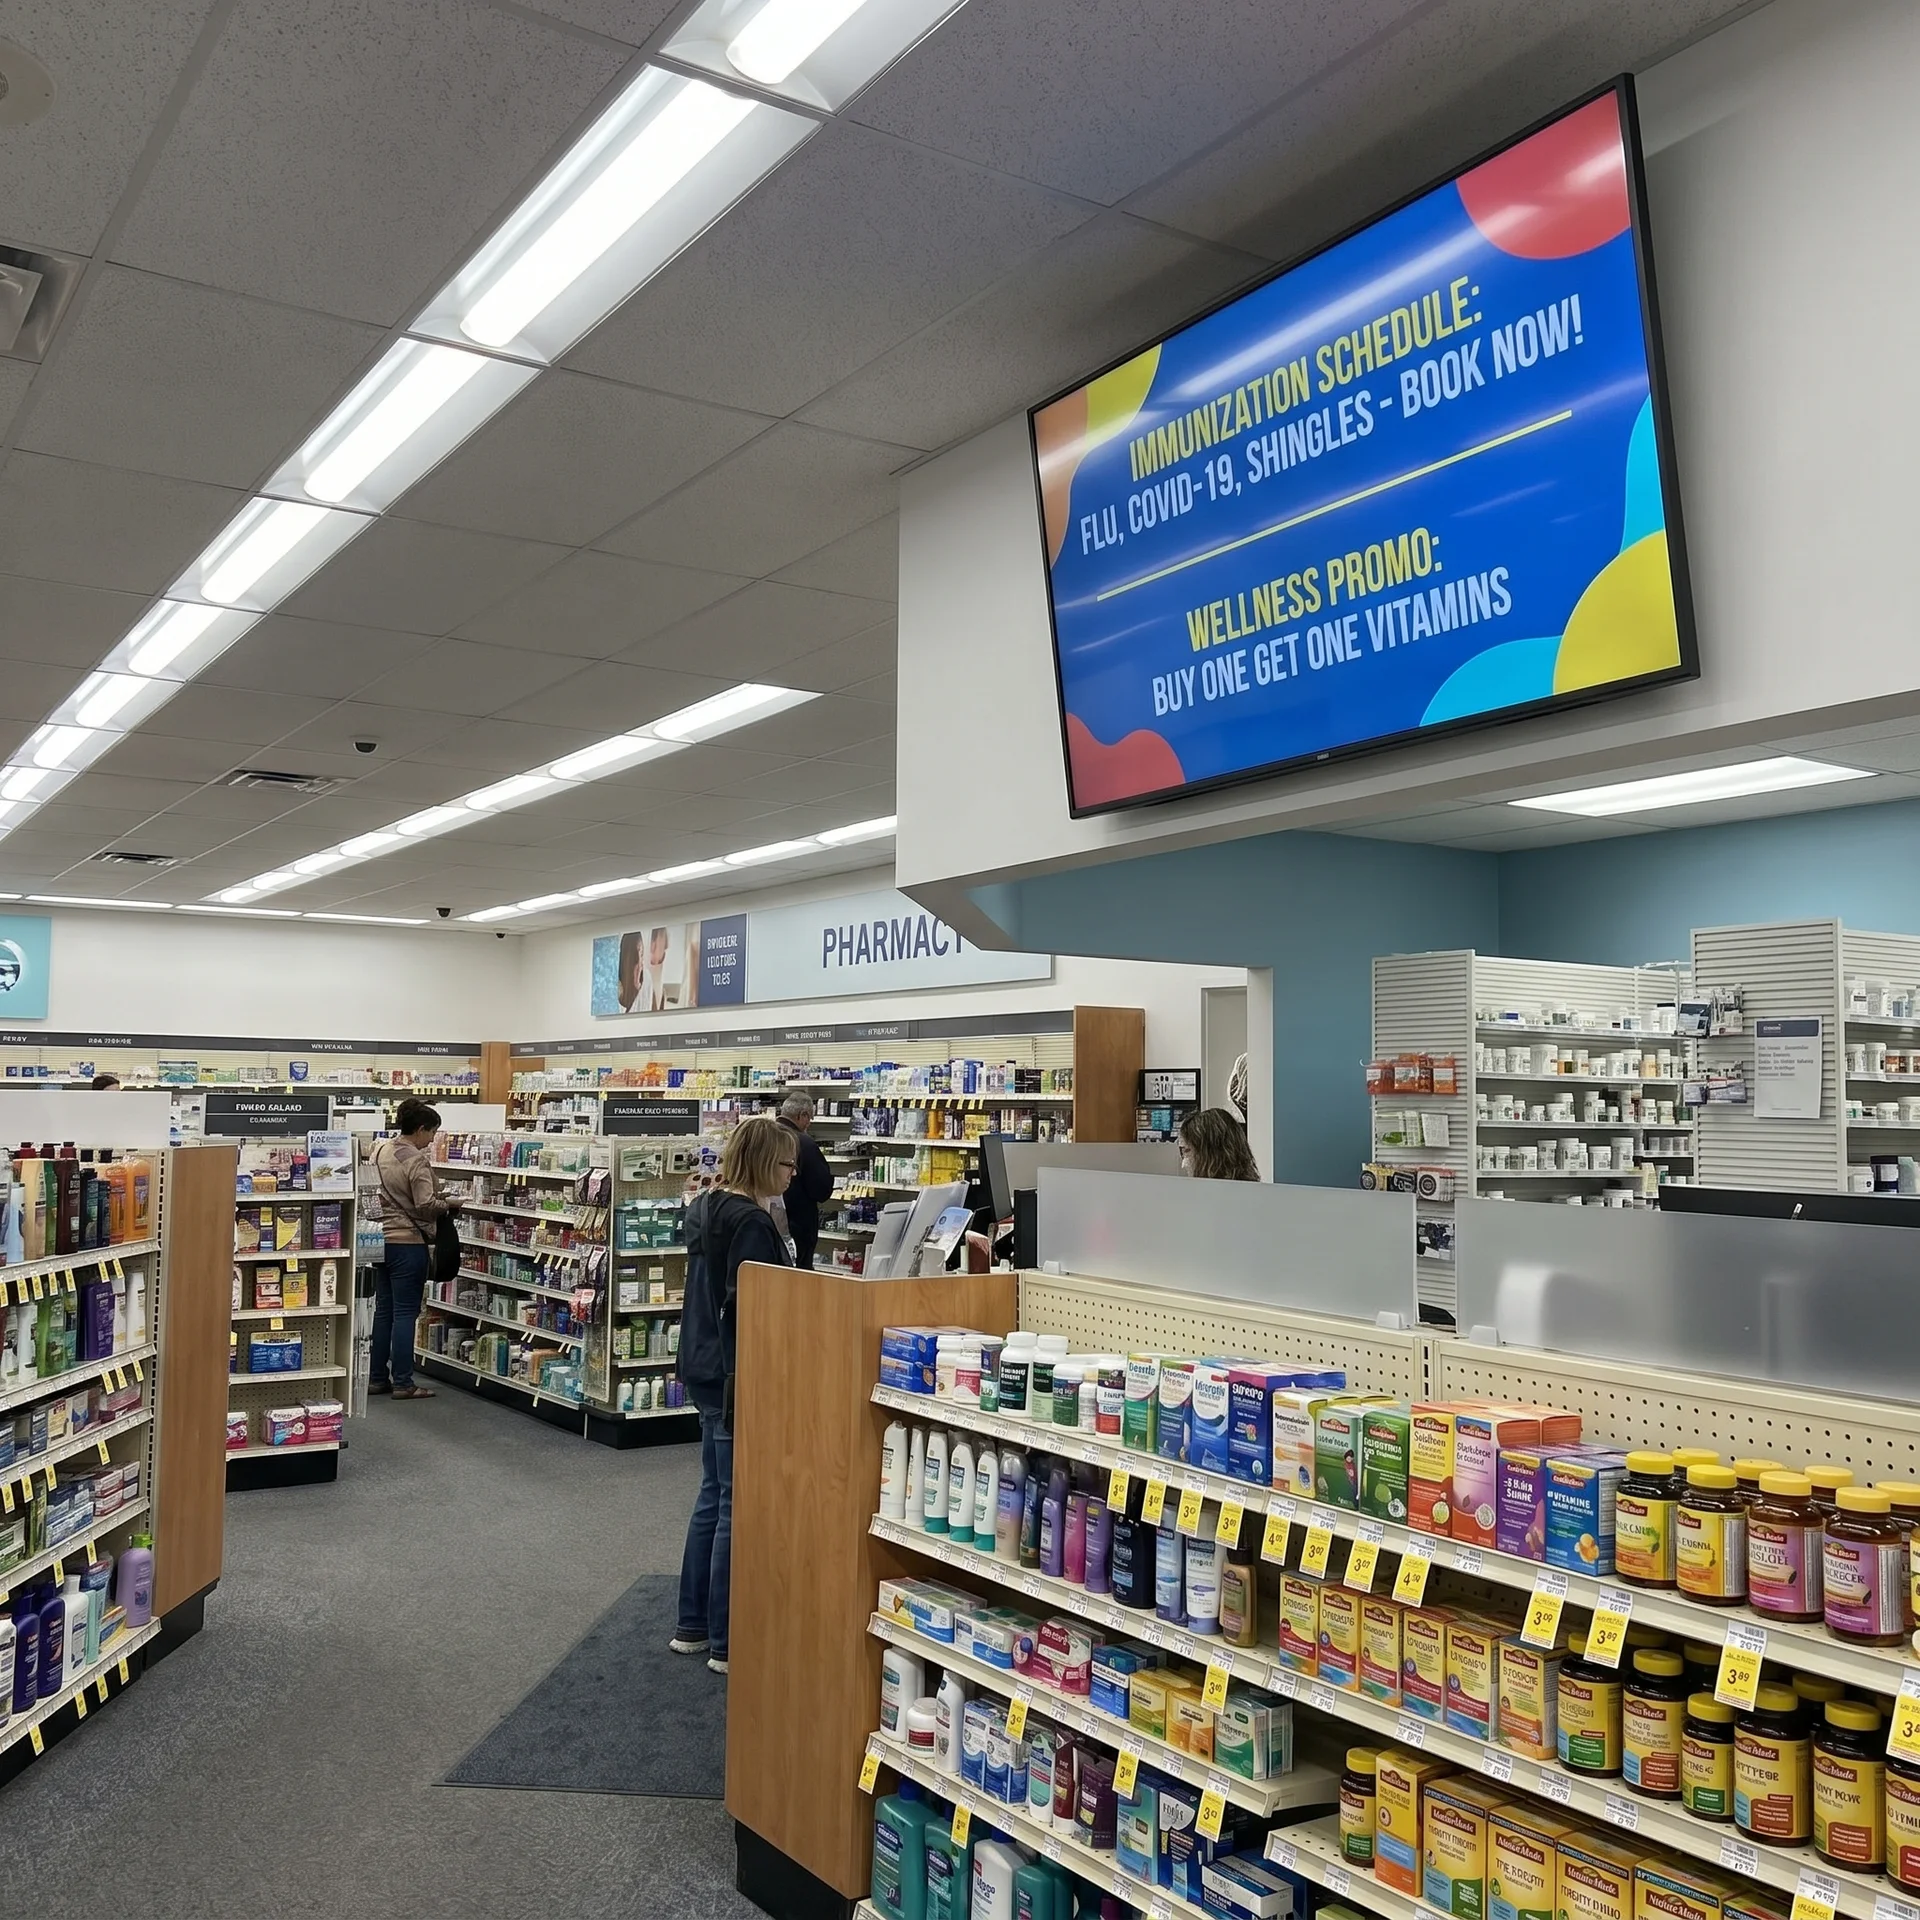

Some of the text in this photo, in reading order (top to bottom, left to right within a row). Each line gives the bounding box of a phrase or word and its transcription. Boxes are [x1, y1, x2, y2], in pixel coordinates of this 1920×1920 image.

[1080, 504, 1124, 556] FLU,
[1128, 453, 1242, 534] COVID-19,
[1246, 389, 1375, 484] SHINGLES
[1400, 337, 1486, 419] BOOK
[1491, 293, 1584, 380] NOW!
[1129, 275, 1483, 482] IMMUNIZATION SCHEDULE:
[1152, 566, 1513, 717] BUY ONE GET ONE VITAMINS
[1186, 527, 1443, 653] WELLNESS PROMO:
